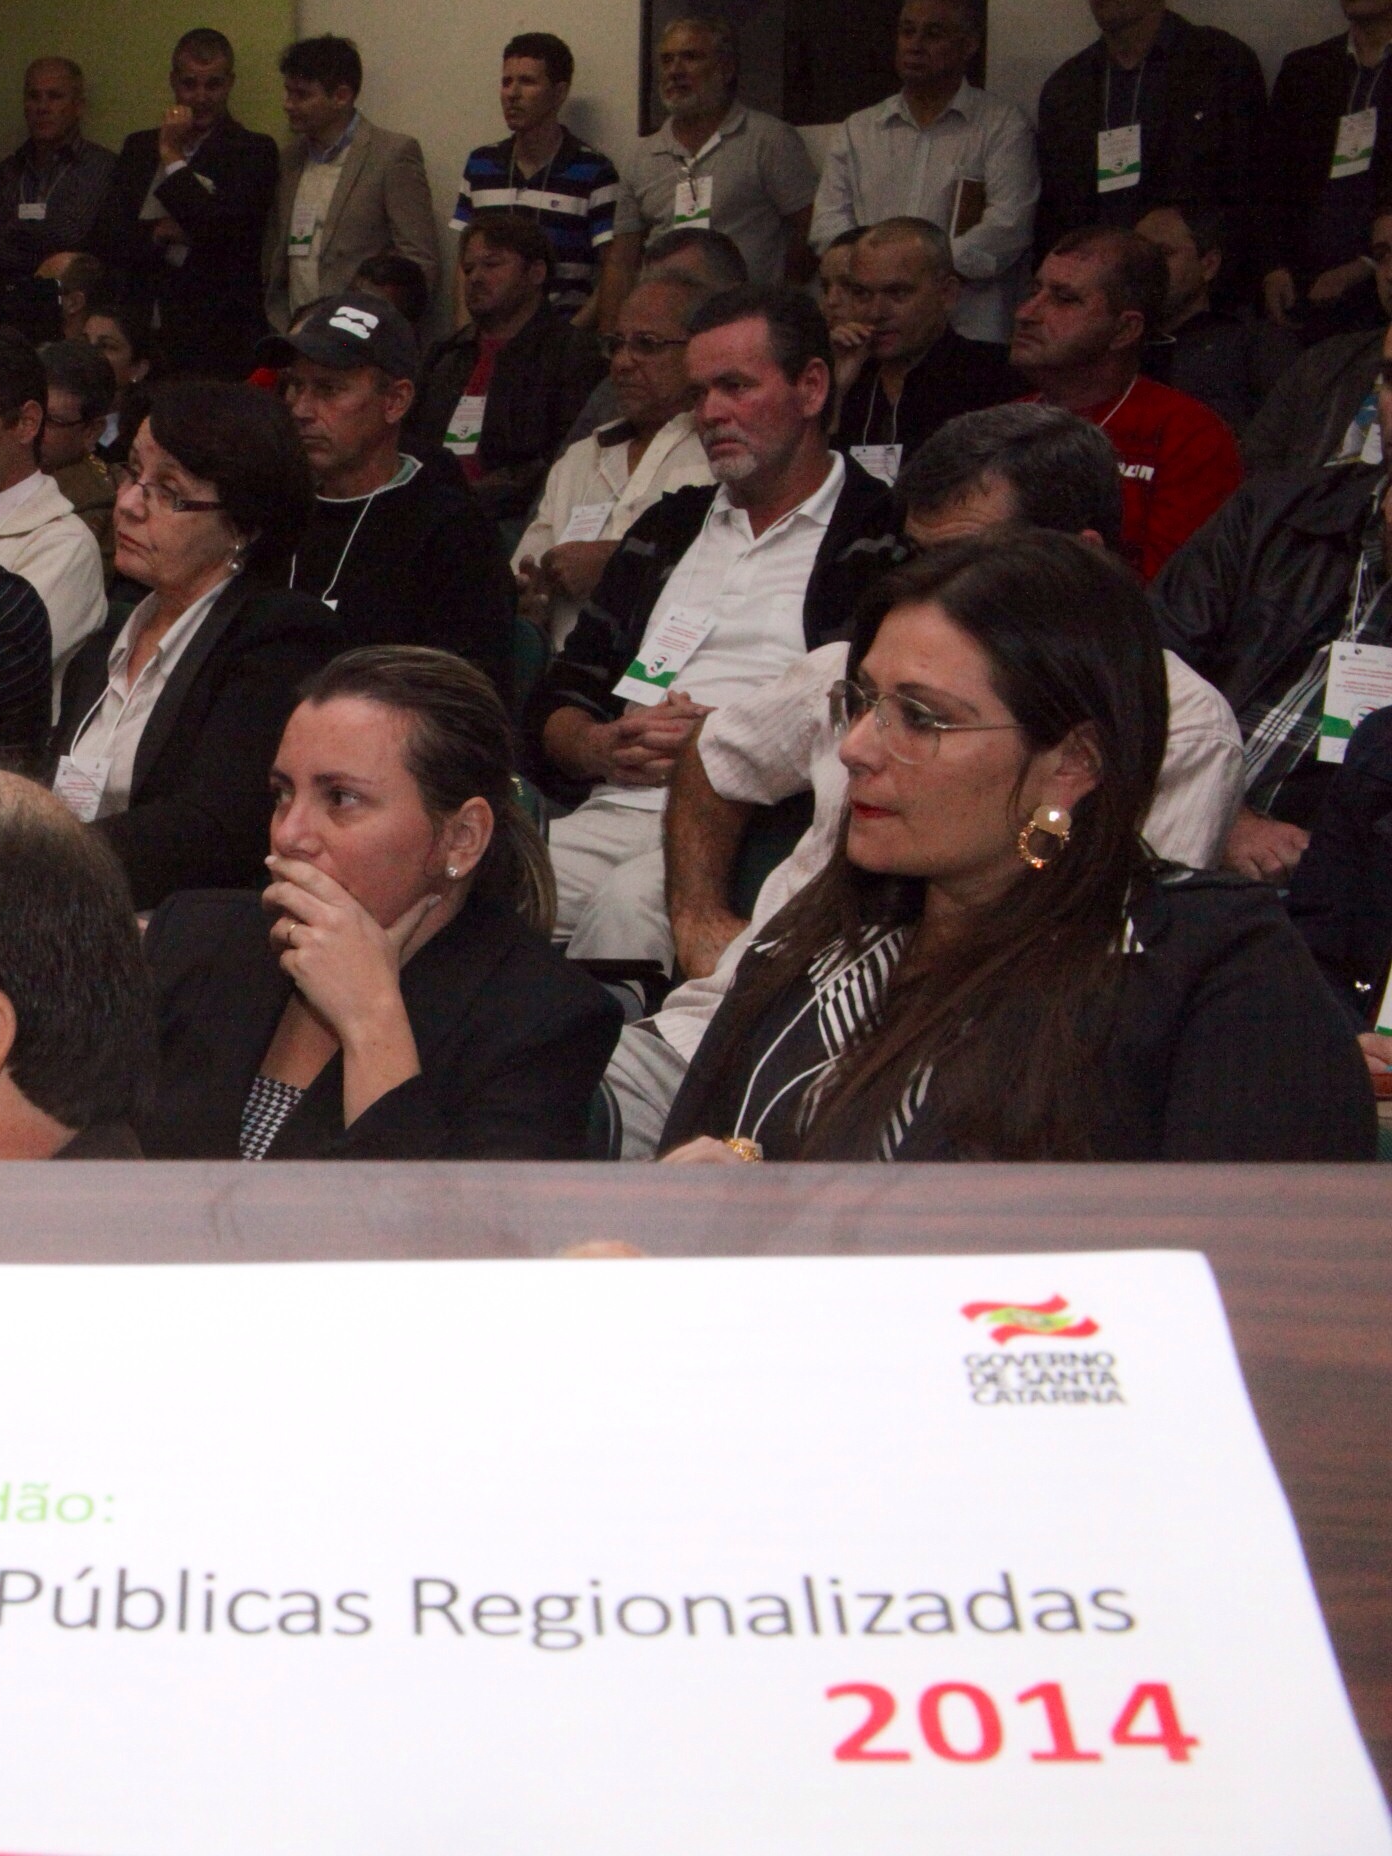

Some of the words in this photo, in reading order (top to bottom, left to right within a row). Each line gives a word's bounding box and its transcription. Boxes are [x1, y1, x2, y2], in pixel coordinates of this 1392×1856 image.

[964, 1352, 1116, 1368] GOVERNO
[969, 1371, 1003, 1386] DE
[1019, 1370, 1118, 1386] SANTA
[972, 1387, 1125, 1404] CATARINA
[411, 1570, 1140, 1652] Regionalizadas
[823, 1679, 1204, 1766] 2014
